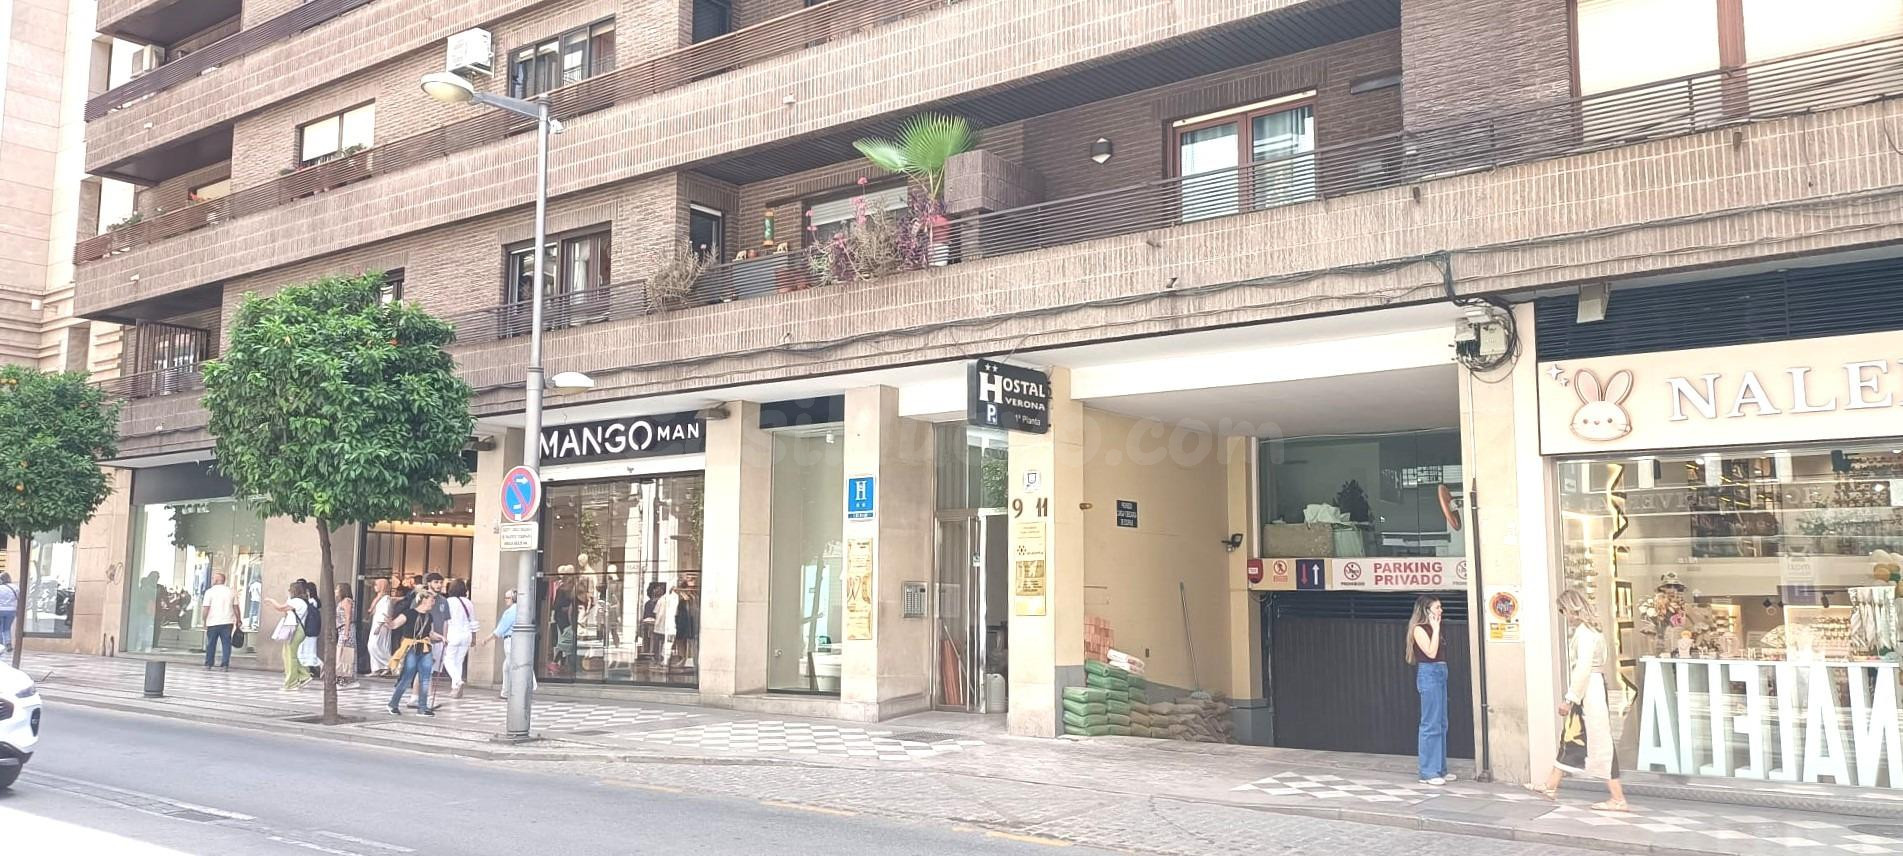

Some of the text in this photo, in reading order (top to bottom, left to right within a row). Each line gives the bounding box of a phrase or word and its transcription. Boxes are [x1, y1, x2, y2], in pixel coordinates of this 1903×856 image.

[979, 371, 1046, 404] HOSTAL
[1665, 358, 1903, 423] NALE
[1004, 396, 1045, 411] VERONA
[1022, 415, 1041, 426] Planta
[540, 420, 700, 459] MANGO MAN
[1012, 497, 1024, 519] 9
[1035, 497, 1049, 518] 11
[1373, 561, 1443, 574] PARKING
[1374, 573, 1443, 587] PRIVADO
